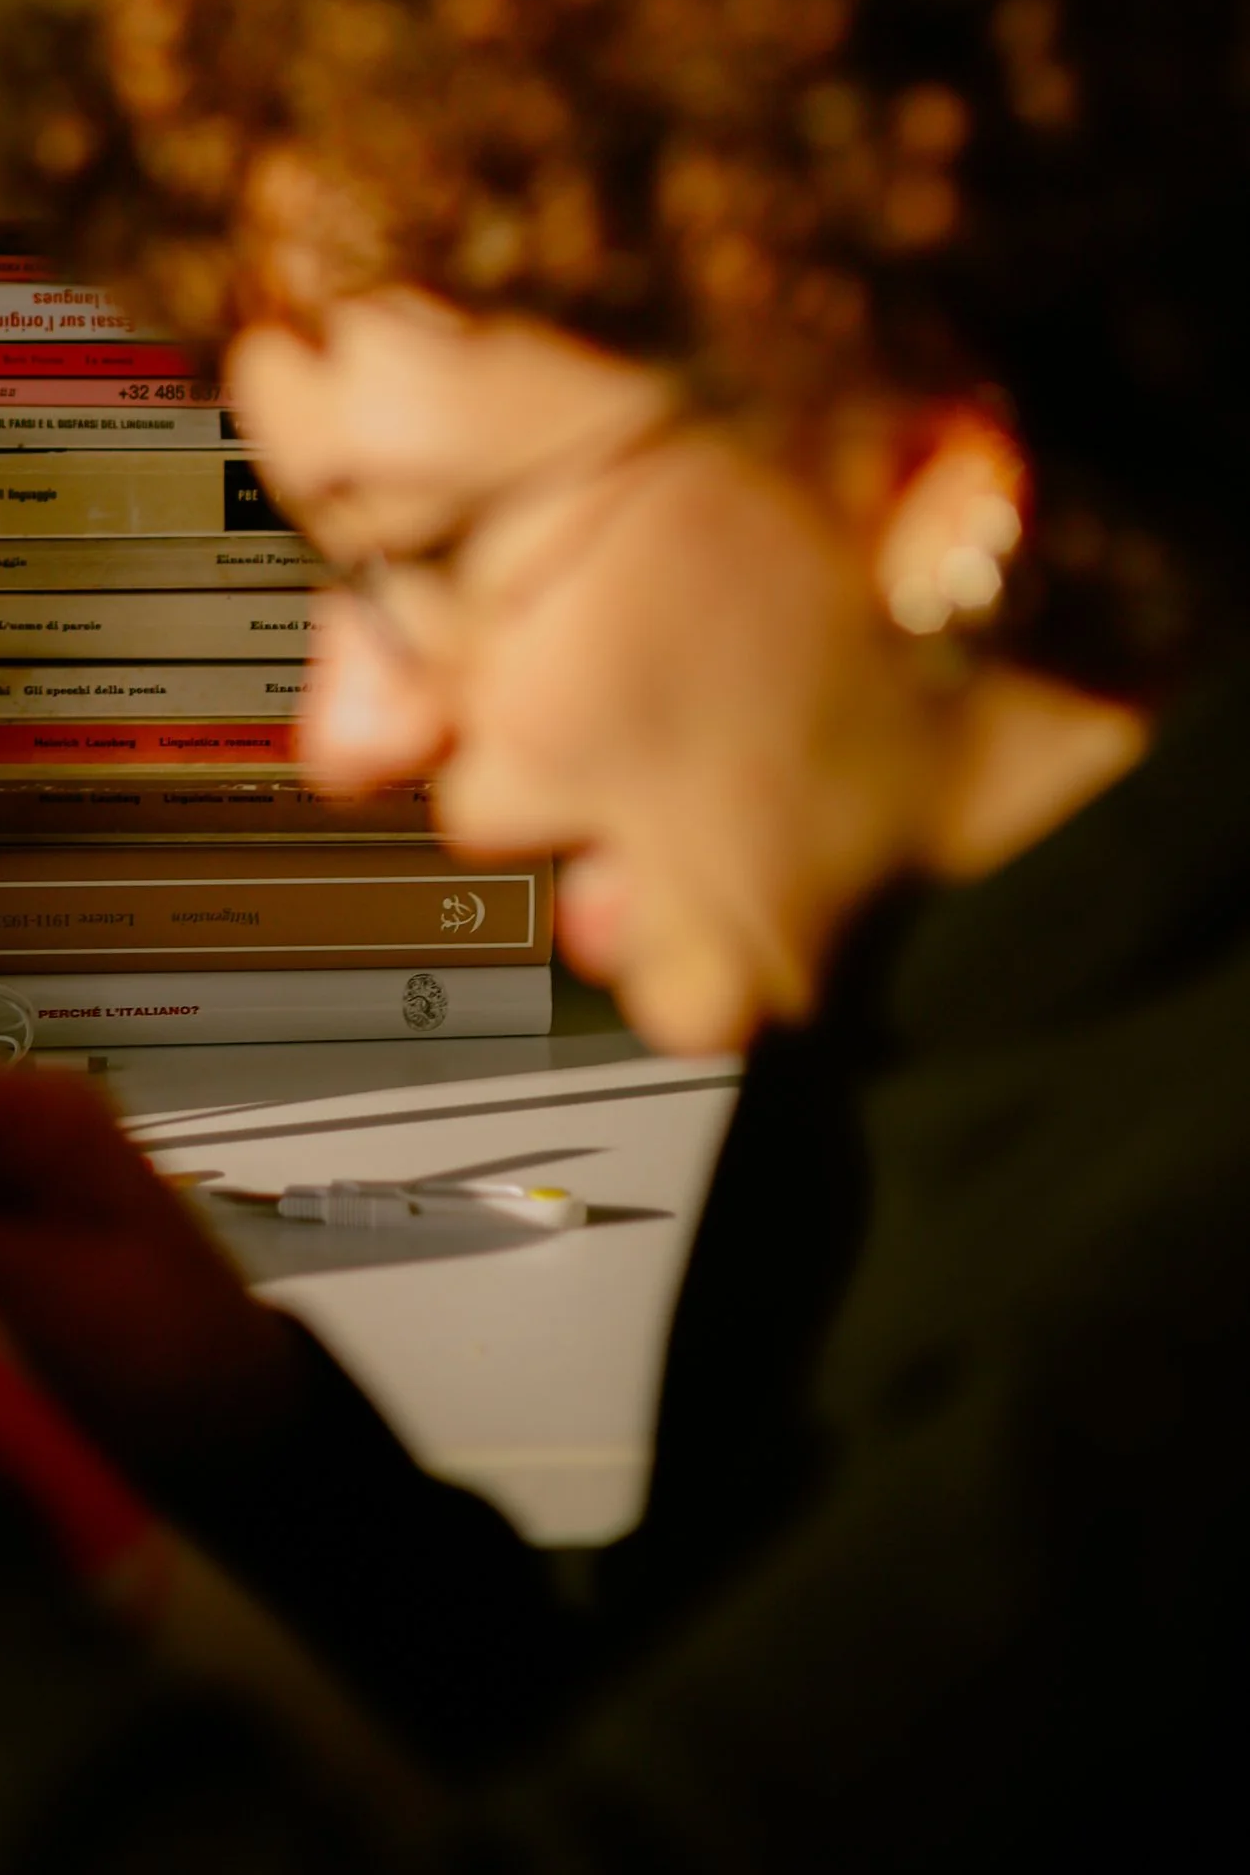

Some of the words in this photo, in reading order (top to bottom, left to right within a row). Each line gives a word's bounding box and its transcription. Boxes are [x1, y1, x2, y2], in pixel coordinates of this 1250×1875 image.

[33, 289, 100, 309] langues
[59, 315, 85, 329] sur
[91, 315, 135, 332] Essai
[118, 384, 150, 400] +32
[155, 384, 185, 400] 485
[9, 418, 37, 429] FARSI
[38, 419, 44, 429] E
[46, 419, 55, 429] IL
[58, 419, 99, 429] DISFARSI
[101, 419, 119, 429] DEL
[121, 419, 175, 430] LINGUAGGIO
[8, 488, 58, 503] linguaggio
[216, 554, 264, 565] Einaudi
[46, 620, 59, 631] di
[62, 621, 102, 632] parole
[250, 620, 299, 630] Einaudi
[23, 685, 44, 695] Gli
[46, 685, 91, 697] specchi
[94, 685, 125, 695] della
[128, 685, 167, 696] poesia
[34, 737, 79, 748] Heinrich
[85, 737, 137, 749] Lausberg
[159, 737, 220, 749] Linguistica
[225, 738, 272, 748] romanza
[77, 912, 134, 926] Lettere
[171, 910, 260, 929] Wittgenstein
[37, 1003, 101, 1019] PERCHÉ
[104, 1002, 199, 1019] L'ITALIANO?
